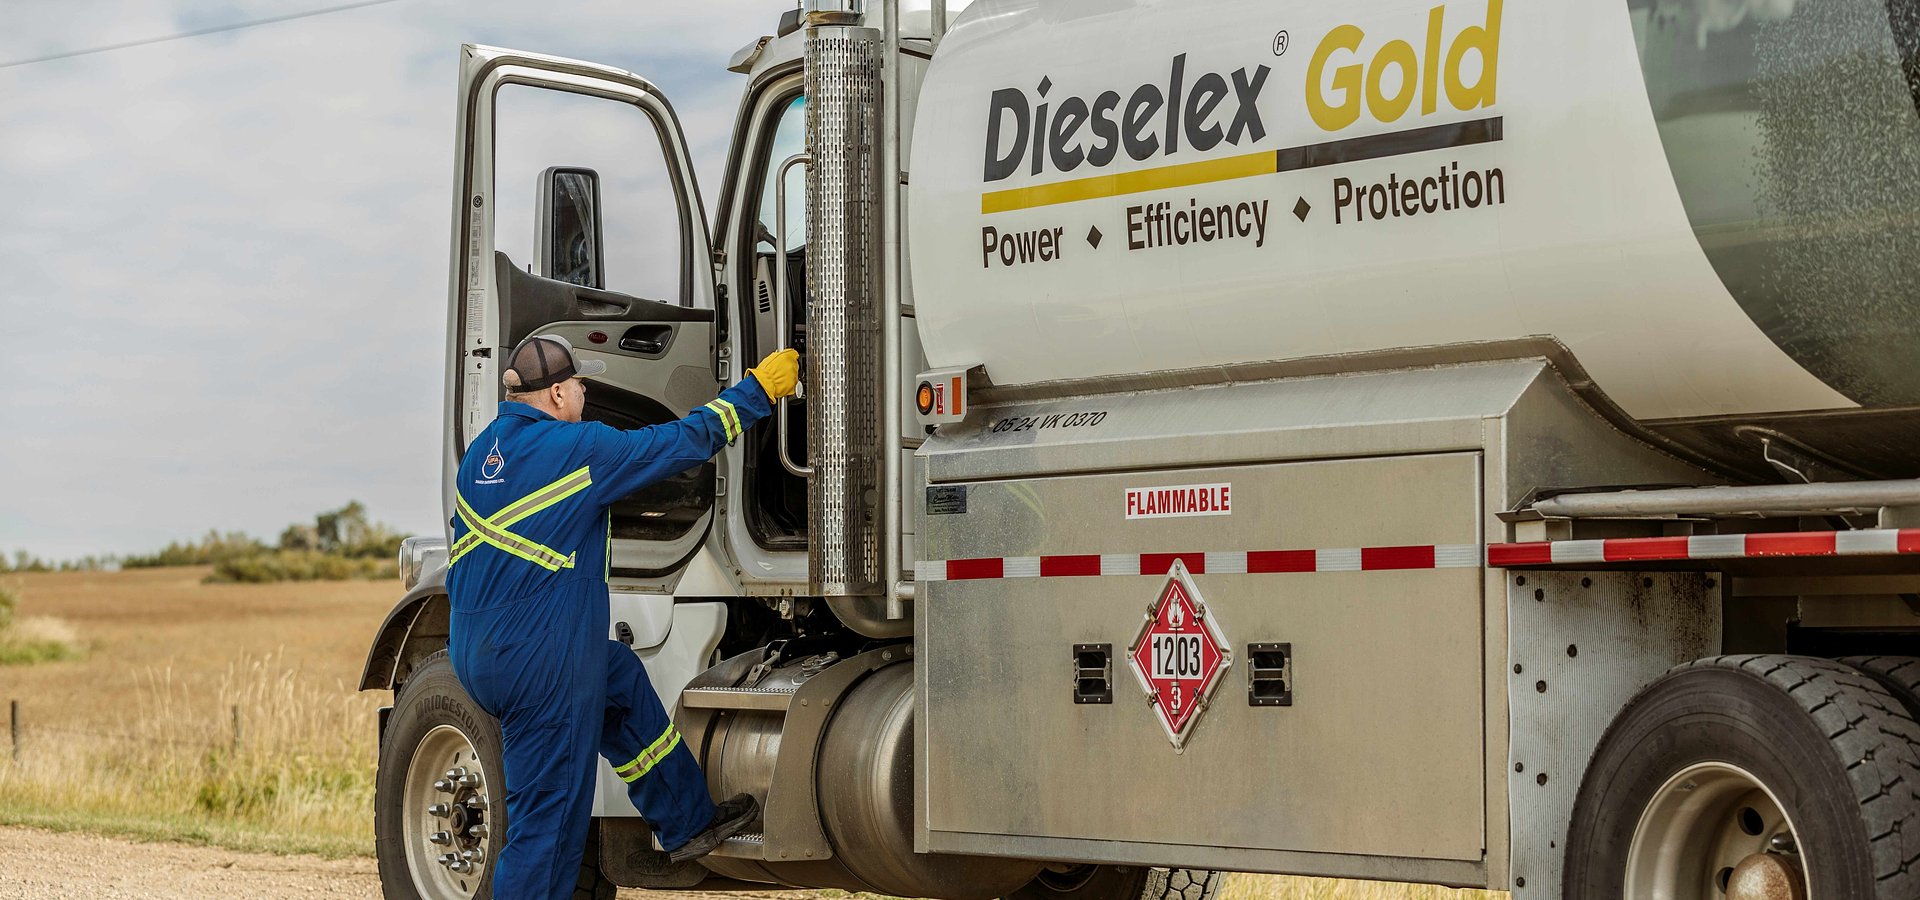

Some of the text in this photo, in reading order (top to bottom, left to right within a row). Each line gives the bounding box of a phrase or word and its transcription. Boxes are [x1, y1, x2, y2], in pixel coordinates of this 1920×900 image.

[983, 53, 1272, 183] Dieselex
[1305, 0, 1503, 132] Gold
[982, 161, 1505, 268] Power Efficiency Protection
[1040, 414, 1067, 429] VK
[1062, 411, 1108, 428] 0370
[1127, 487, 1230, 515] FLAMMABLE
[1153, 636, 1201, 677] 1203
[1170, 685, 1182, 710] 3
[415, 694, 486, 751] BRIDGESTONE
